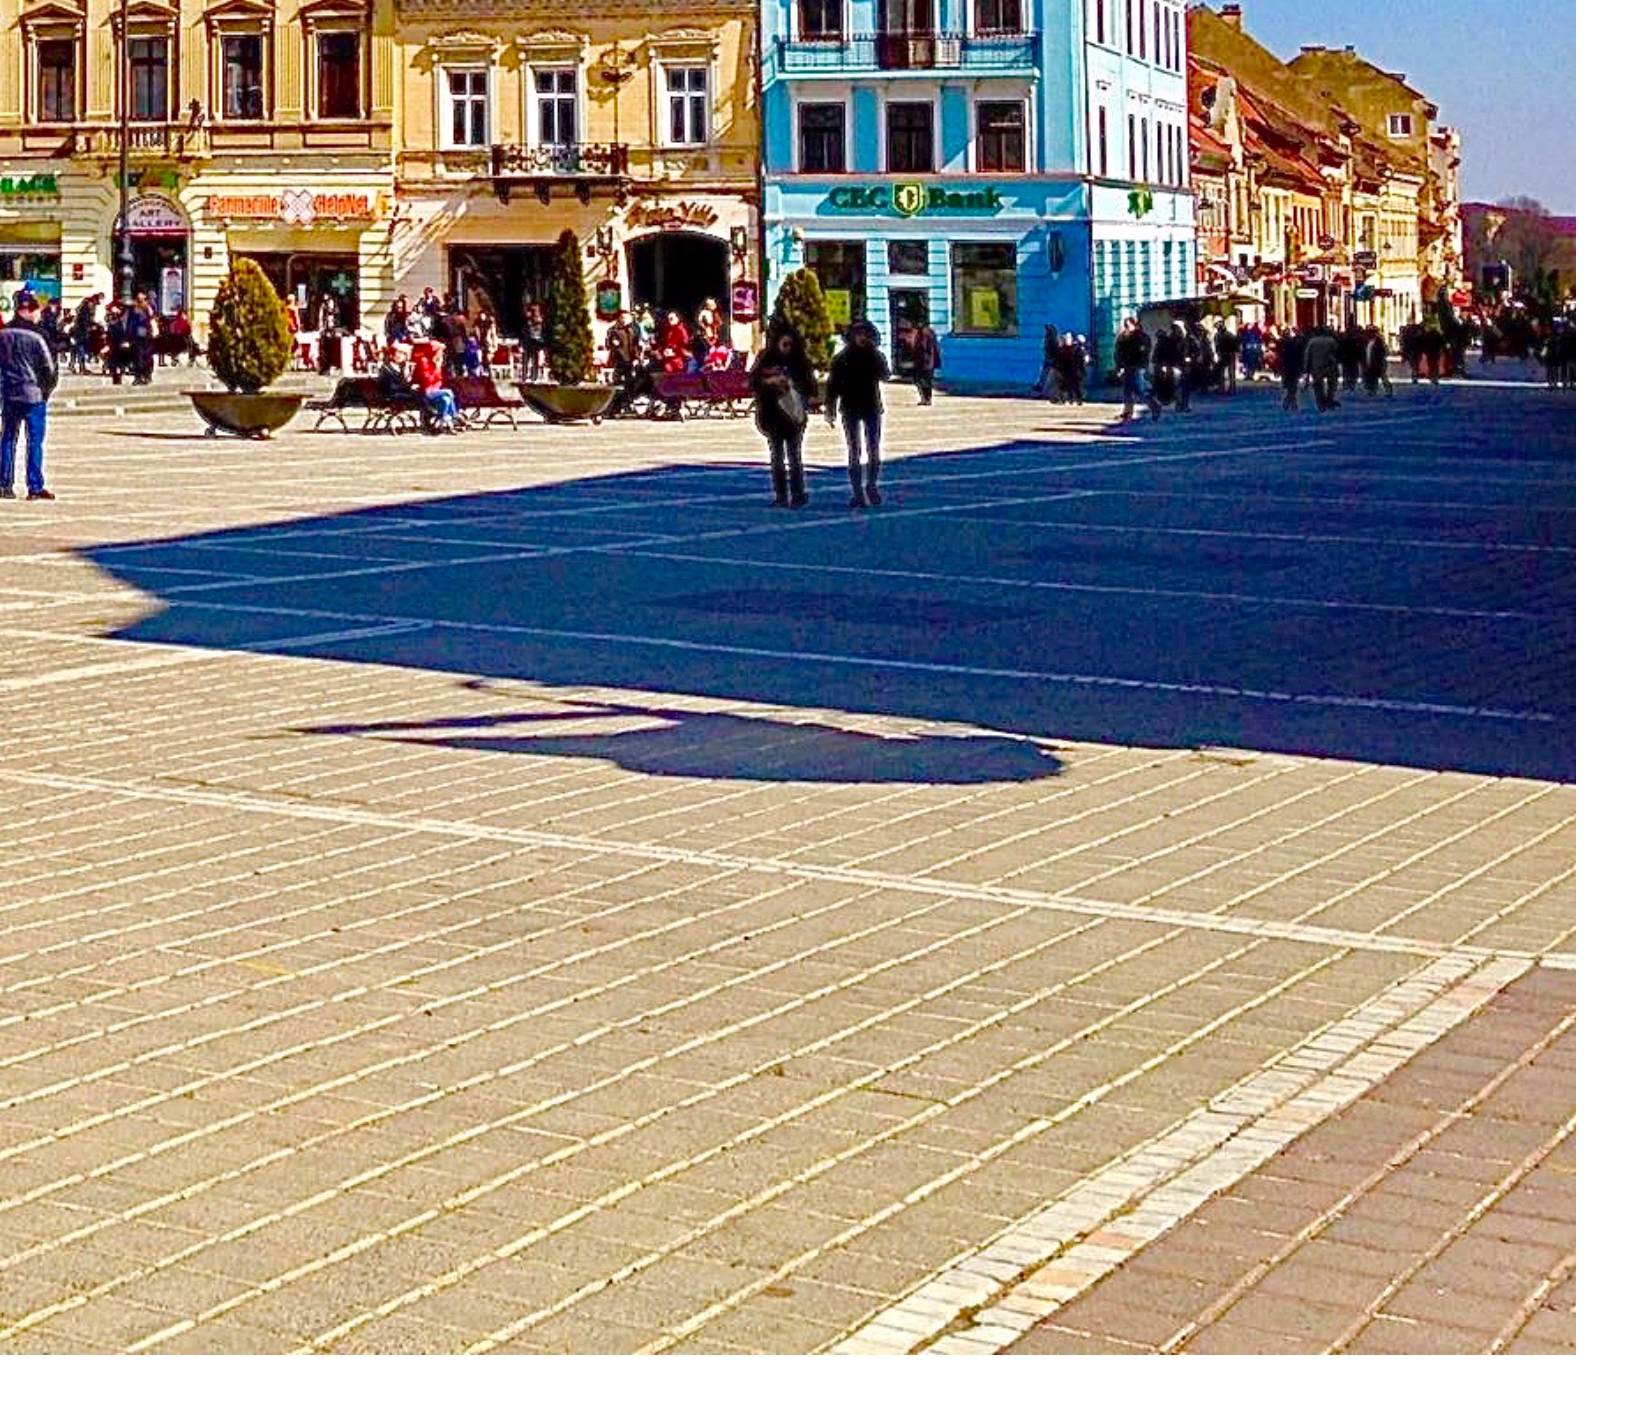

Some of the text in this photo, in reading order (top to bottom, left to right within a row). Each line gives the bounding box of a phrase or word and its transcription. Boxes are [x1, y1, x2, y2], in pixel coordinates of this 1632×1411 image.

[829, 187, 1004, 208] CEC Bank
[128, 219, 183, 228] ALLERY
